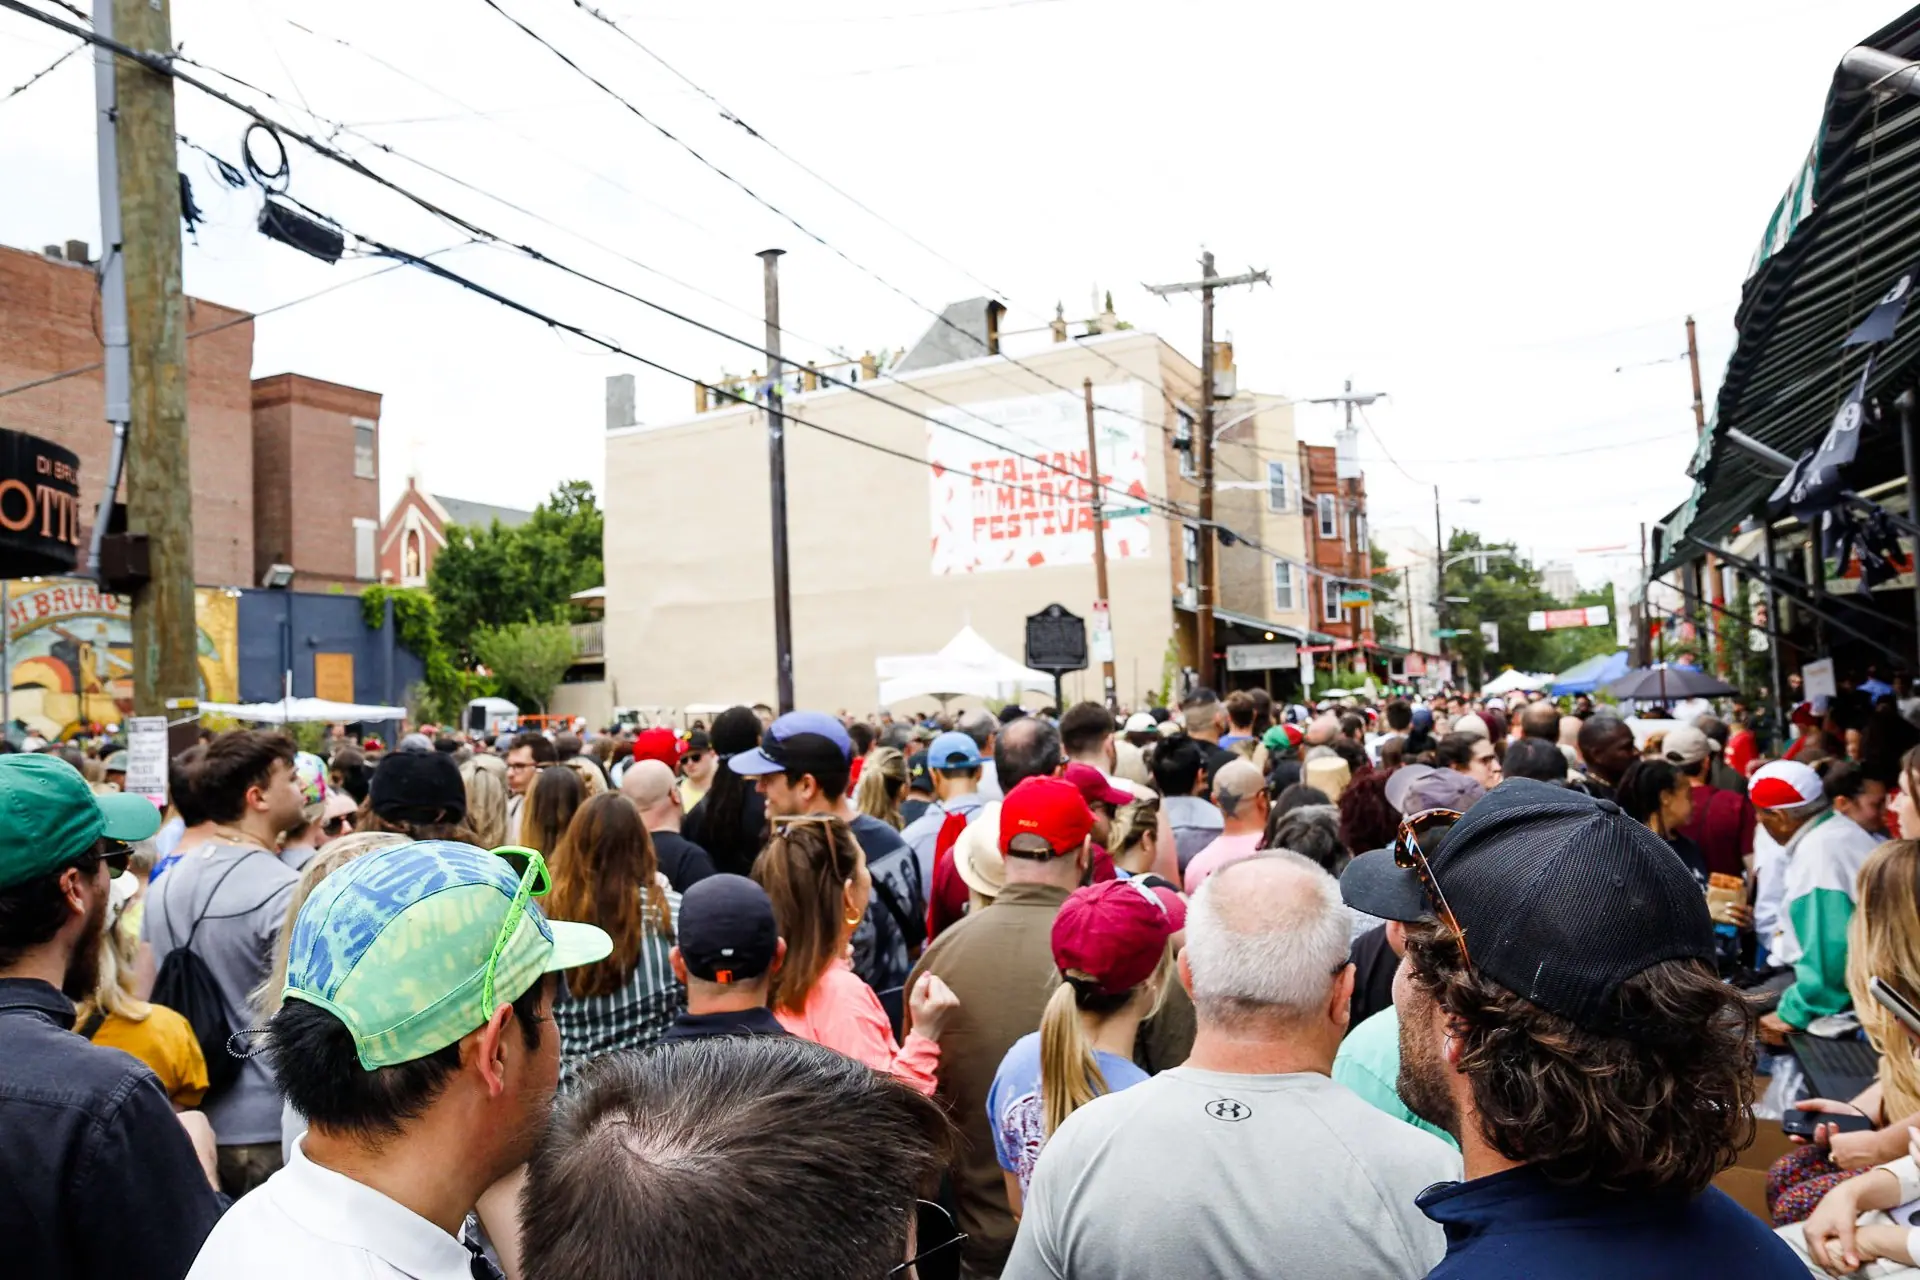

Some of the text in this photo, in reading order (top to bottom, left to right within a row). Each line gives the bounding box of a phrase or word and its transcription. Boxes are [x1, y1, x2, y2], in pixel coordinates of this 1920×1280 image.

[36, 455, 52, 476] DI
[971, 449, 1087, 486] ITALIAN
[996, 475, 1113, 510] MARKET
